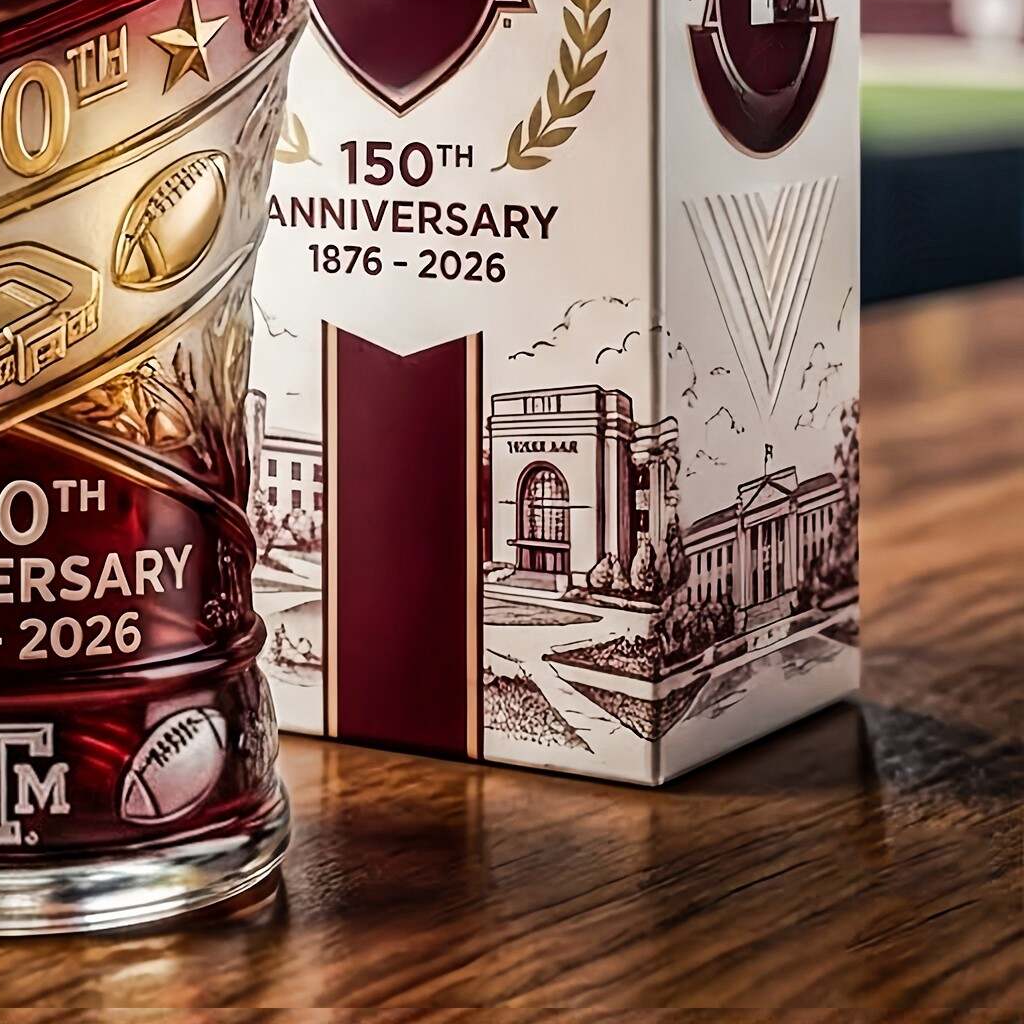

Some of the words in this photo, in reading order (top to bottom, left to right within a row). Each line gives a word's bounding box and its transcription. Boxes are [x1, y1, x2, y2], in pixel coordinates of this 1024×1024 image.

[340, 140, 474, 187] 150TH
[268, 194, 559, 239] ANNIVERSARY
[308, 244, 383, 276] 1876
[417, 249, 507, 283] 2026
[18, 611, 143, 661] 2026
